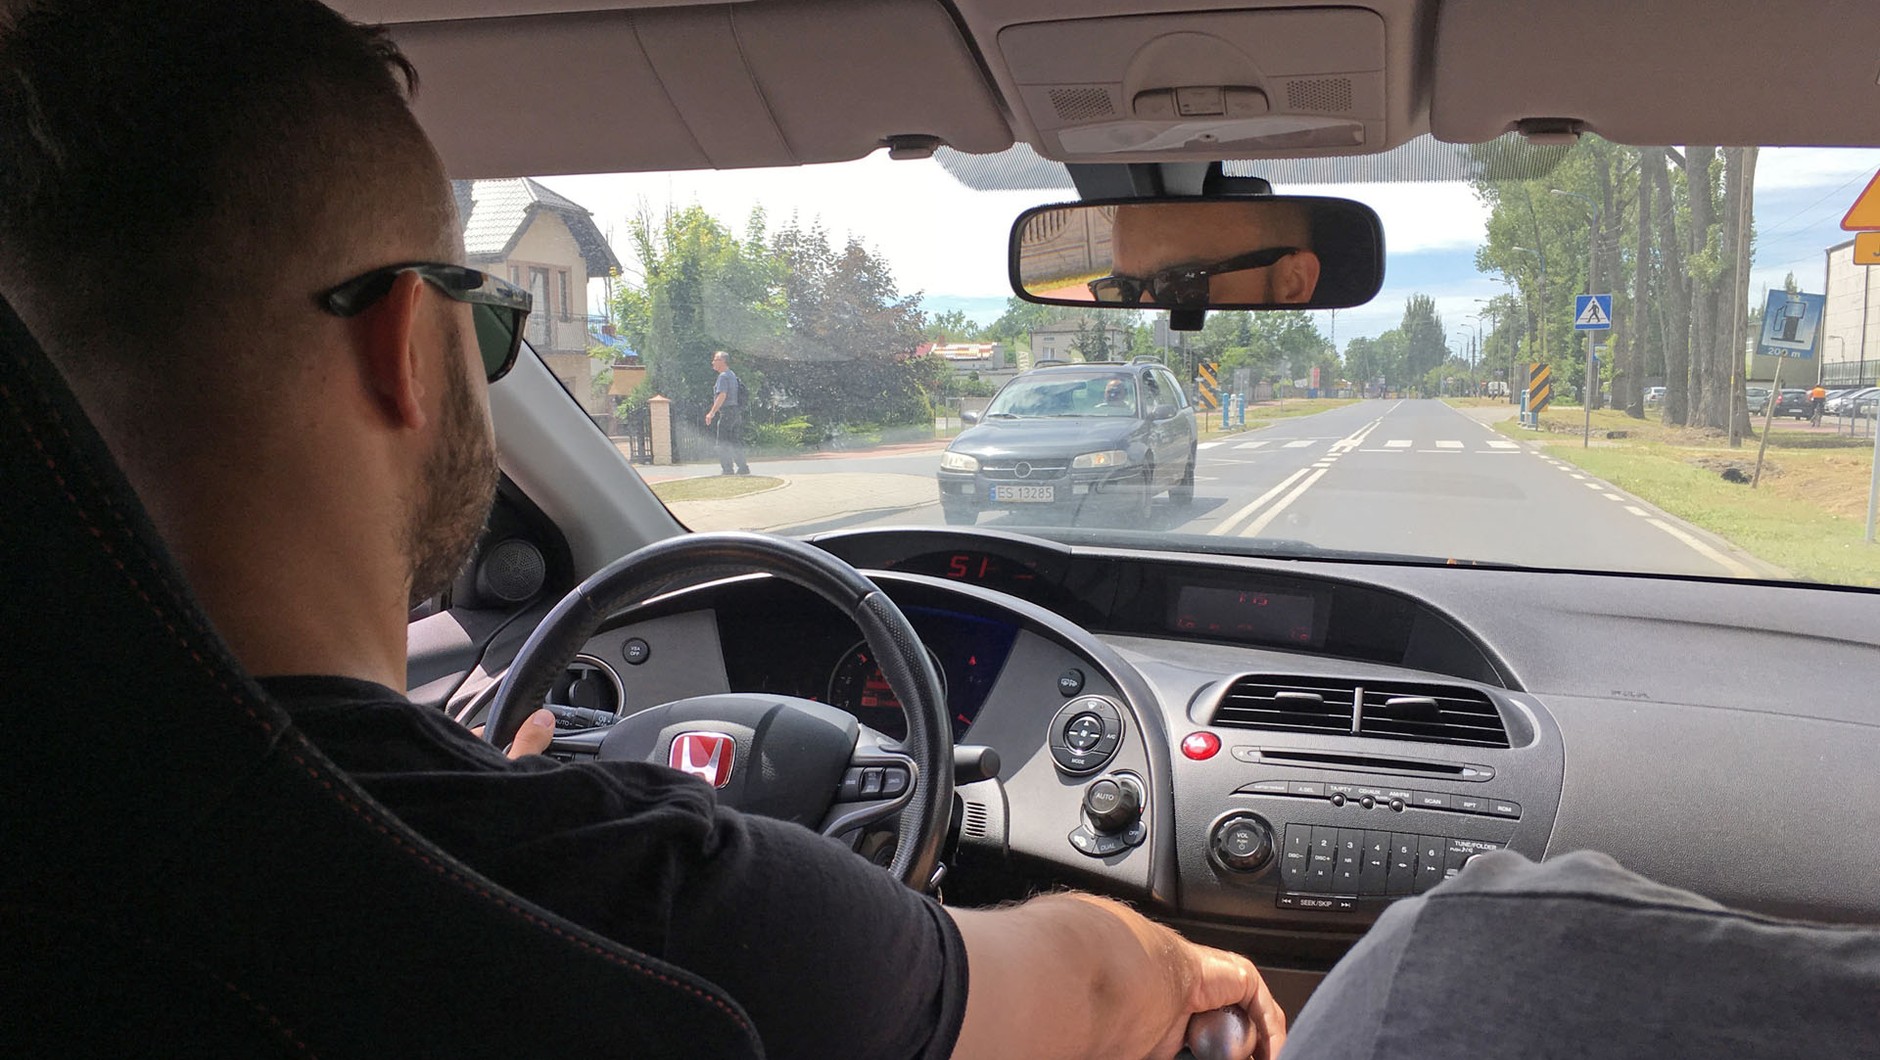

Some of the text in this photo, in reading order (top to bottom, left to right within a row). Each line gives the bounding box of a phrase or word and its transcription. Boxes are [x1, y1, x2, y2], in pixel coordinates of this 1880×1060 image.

[1768, 347, 1801, 359] 200 m
[997, 486, 1052, 499] ES 13285
[1071, 757, 1085, 765] MODE
[1095, 792, 1115, 801] AUTO
[1424, 797, 1442, 805] SCAN
[1100, 842, 1116, 851] DUAL
[1320, 839, 1328, 847] 2
[1346, 841, 1354, 849] 3
[1454, 840, 1497, 851] TUNE/FOLDER
[1401, 846, 1407, 854] 5
[1428, 849, 1435, 857] 6
[1300, 899, 1333, 907] SEEK/SKIP
